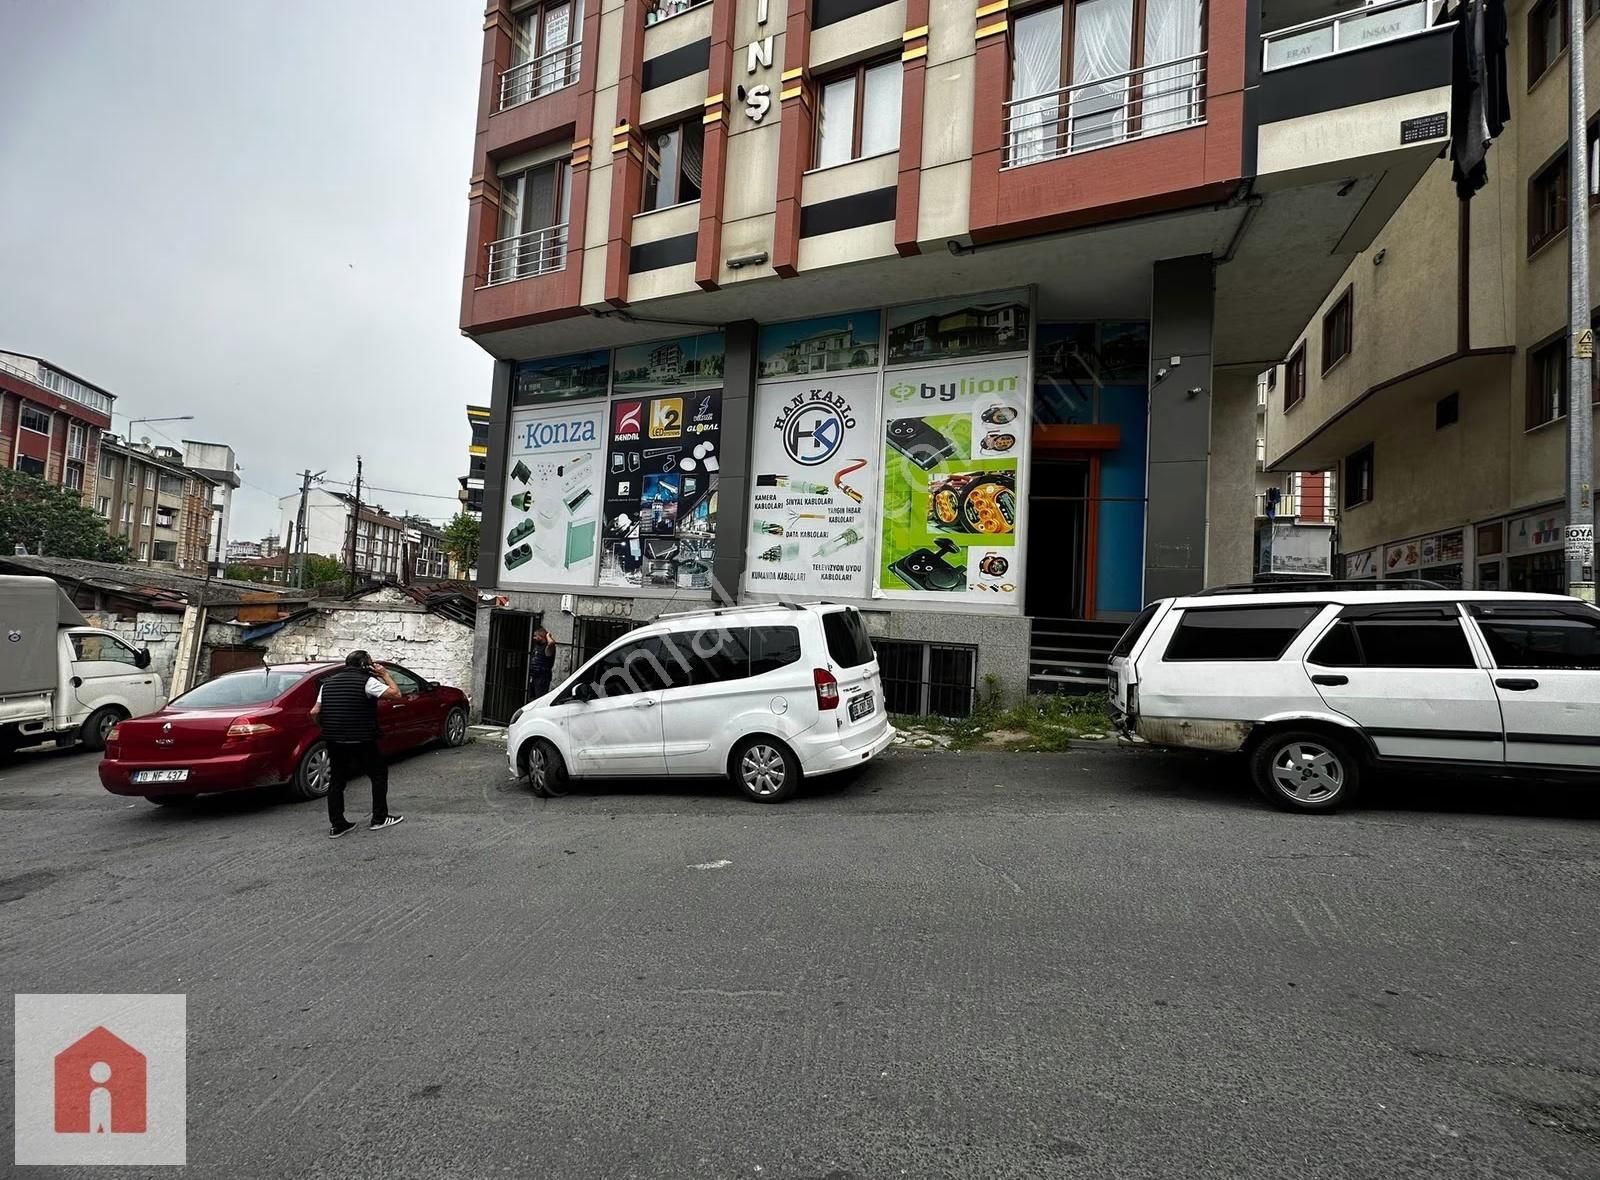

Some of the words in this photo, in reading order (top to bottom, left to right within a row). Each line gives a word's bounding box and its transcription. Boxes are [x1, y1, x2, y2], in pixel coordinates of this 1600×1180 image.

[773, 393, 805, 431] HAN
[808, 389, 857, 429] KABLO
[686, 423, 720, 435] GLOBAL
[524, 419, 597, 450] Konza
[804, 497, 834, 505] KABLOLARI
[754, 502, 784, 510] KABLOLARI
[785, 531, 799, 539] DATA
[799, 531, 829, 539] KABLOLARI
[1565, 529, 1593, 538] BOYA
[777, 572, 807, 581] KABLOLARI
[820, 573, 852, 581] KABLOLARI
[166, 770, 183, 781] 437
